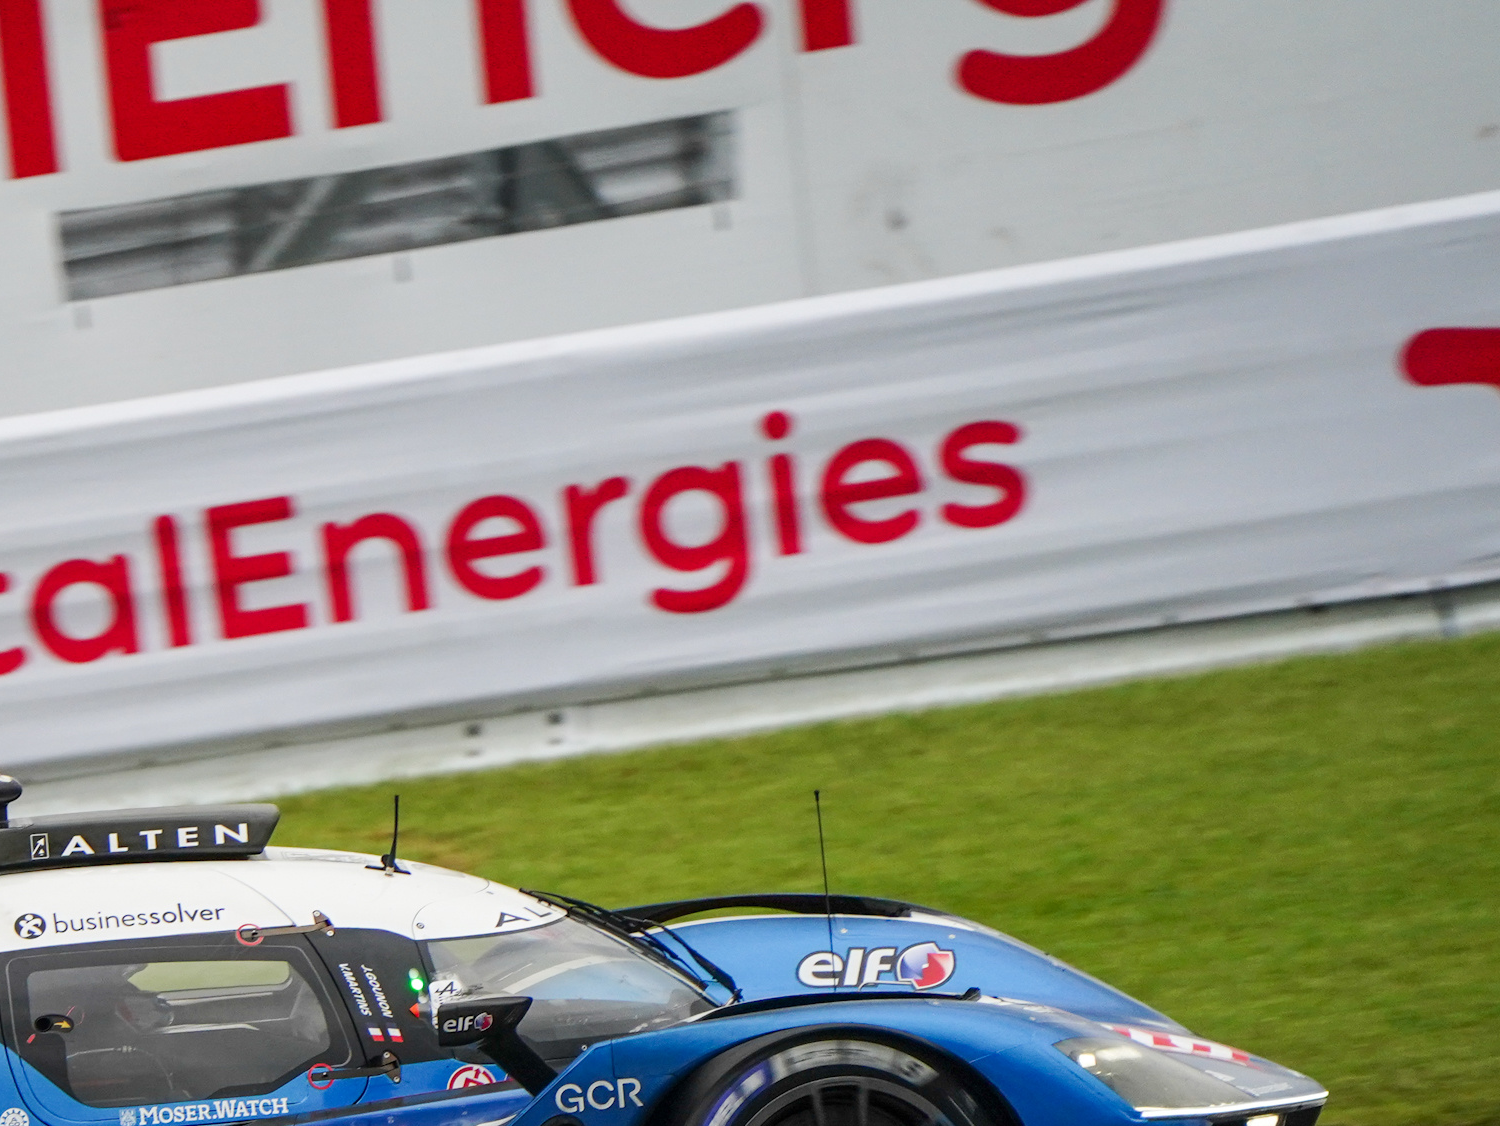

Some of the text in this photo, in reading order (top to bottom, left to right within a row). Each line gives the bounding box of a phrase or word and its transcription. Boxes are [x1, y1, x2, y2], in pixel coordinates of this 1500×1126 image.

[61, 822, 250, 857] ALTEN
[52, 902, 226, 934] businessolver
[798, 946, 897, 988] elf
[338, 963, 373, 1017] V.MARTINS
[442, 1015, 475, 1033] elf
[554, 1076, 645, 1114] GCR
